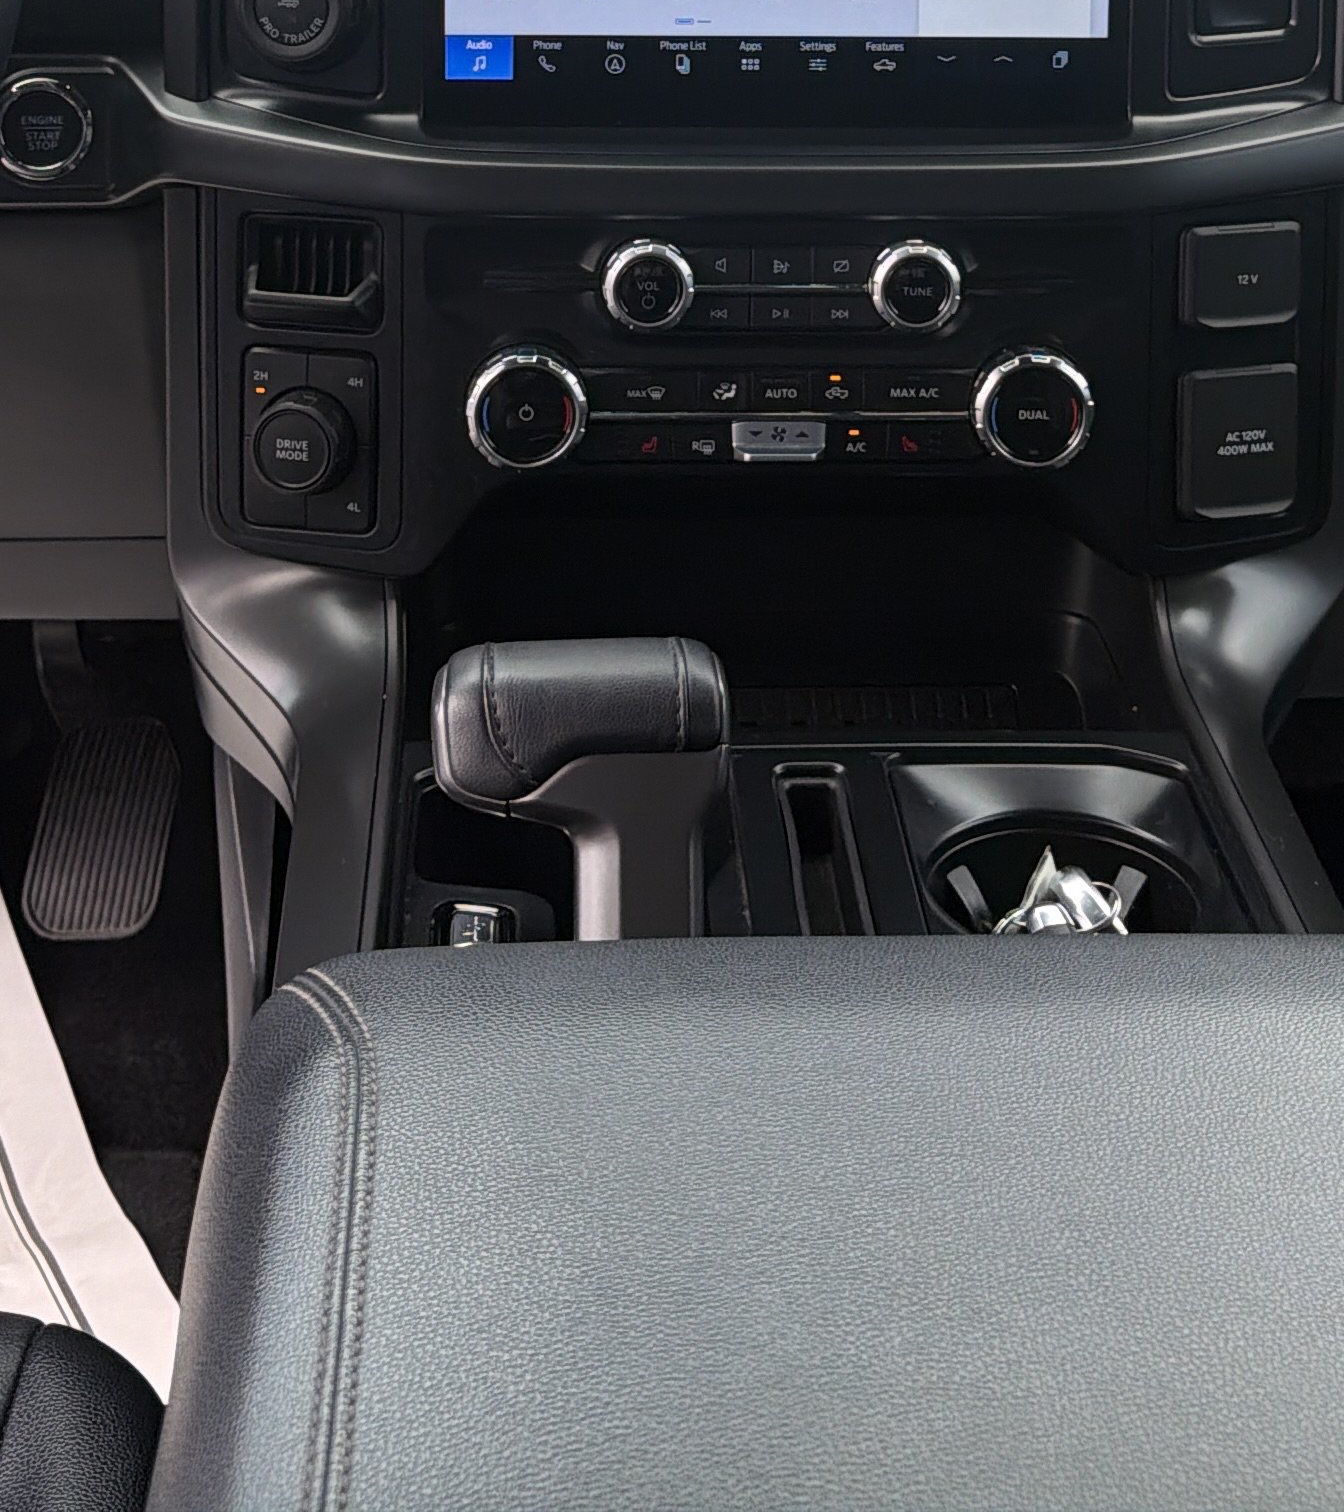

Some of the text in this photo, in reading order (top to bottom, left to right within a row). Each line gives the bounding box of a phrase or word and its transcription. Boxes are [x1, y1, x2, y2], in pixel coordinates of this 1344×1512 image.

[258, 16, 325, 44] PRO TRAILER
[465, 39, 493, 51] Audio
[532, 39, 562, 51] Phone
[606, 40, 625, 51] Nav
[659, 40, 707, 52] Phone List
[738, 41, 763, 55] Apps
[799, 41, 837, 54] Settings
[865, 41, 904, 53] Features
[20, 115, 64, 126] ENGINE
[25, 131, 61, 141] START
[28, 141, 59, 151] STOP
[1237, 273, 1259, 285] 12 V
[637, 281, 660, 291] VOL
[903, 287, 934, 297] TUNE
[253, 370, 269, 381] 2H
[347, 377, 364, 388] 4H
[626, 389, 647, 398] MAX
[765, 388, 798, 399] AUTO
[890, 388, 940, 399] MAX A/C
[1018, 410, 1050, 421] DUAL
[1226, 429, 1267, 442] AC 120V
[275, 438, 309, 451] DRIVE
[846, 443, 867, 453] A/C
[1217, 441, 1274, 456] 400W MAX
[275, 450, 309, 462] MODE
[346, 502, 361, 513] 4L
